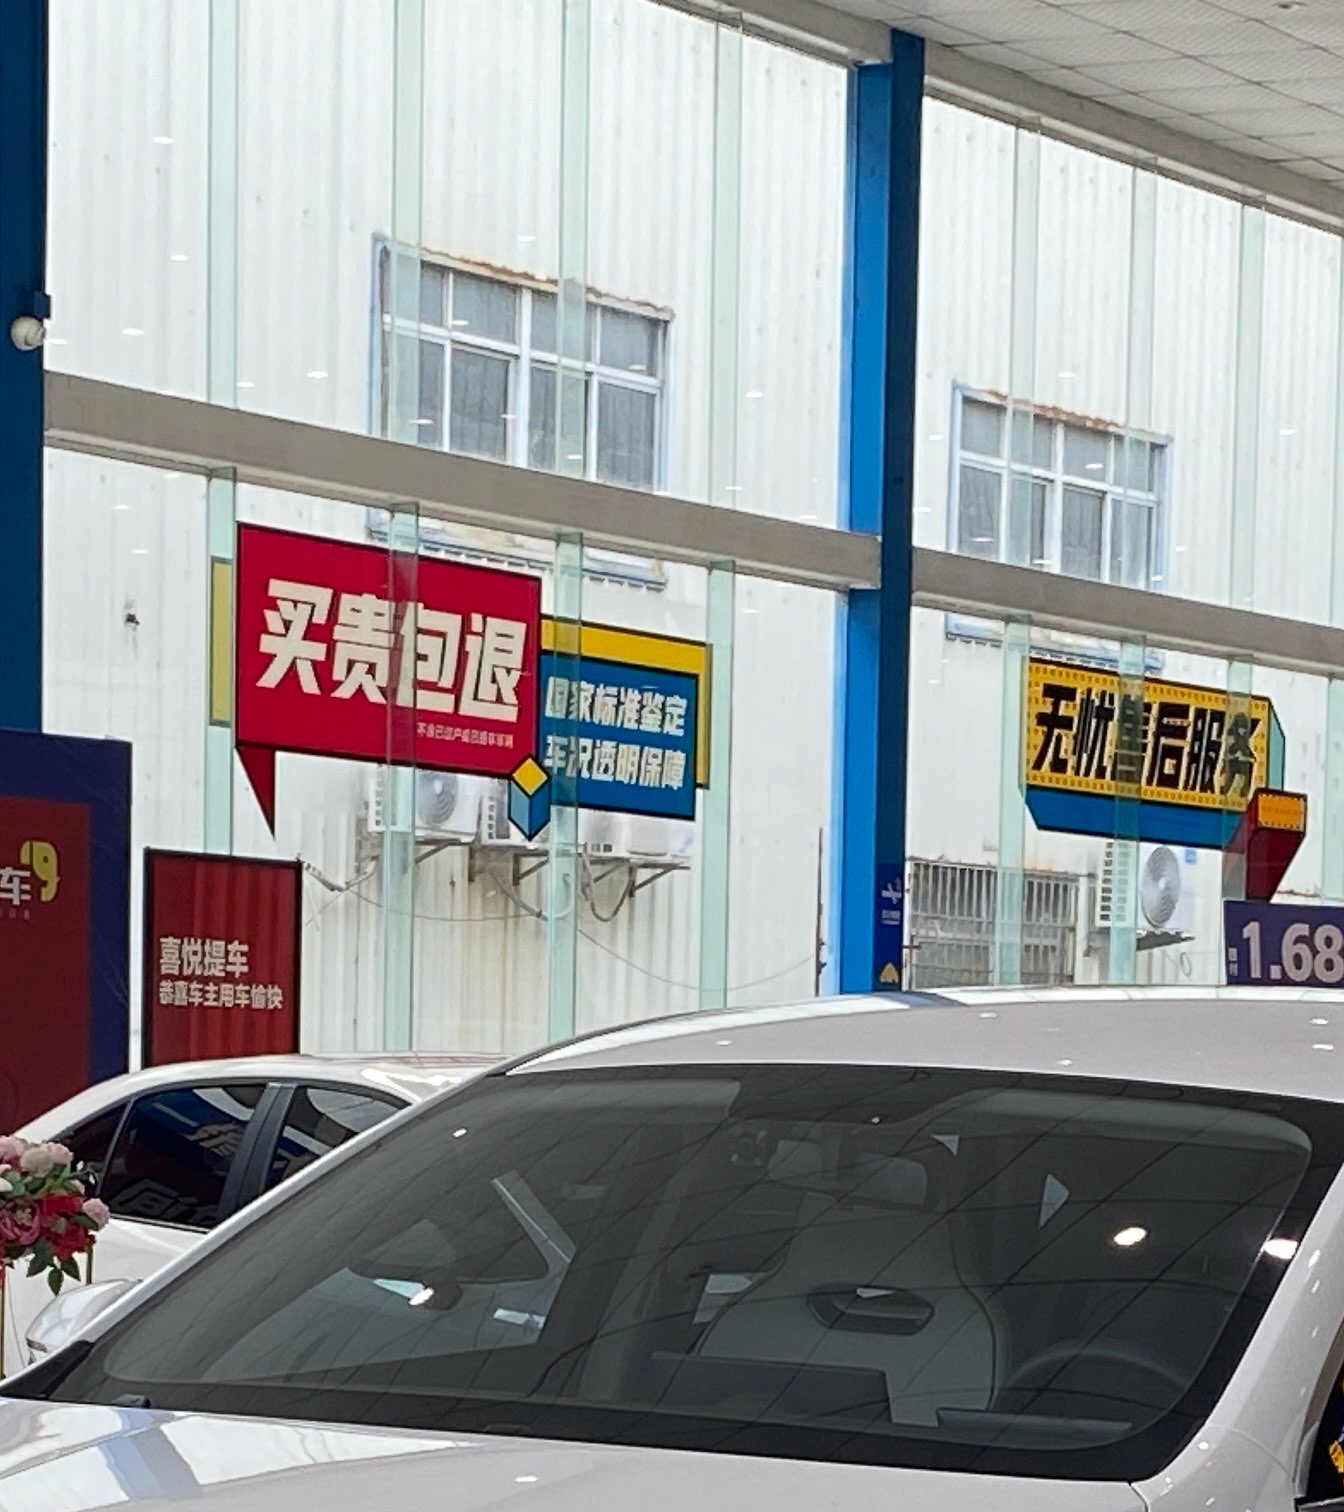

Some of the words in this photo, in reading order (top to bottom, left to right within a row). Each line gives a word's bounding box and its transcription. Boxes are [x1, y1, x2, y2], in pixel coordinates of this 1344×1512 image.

[256, 578, 528, 722] 买贵包退
[545, 676, 687, 737] 国家标准鉴定
[544, 734, 687, 791] 车况透明保障
[159, 936, 249, 979] 喜悦提车
[159, 979, 283, 1010] 恭喜车主用车愉快
